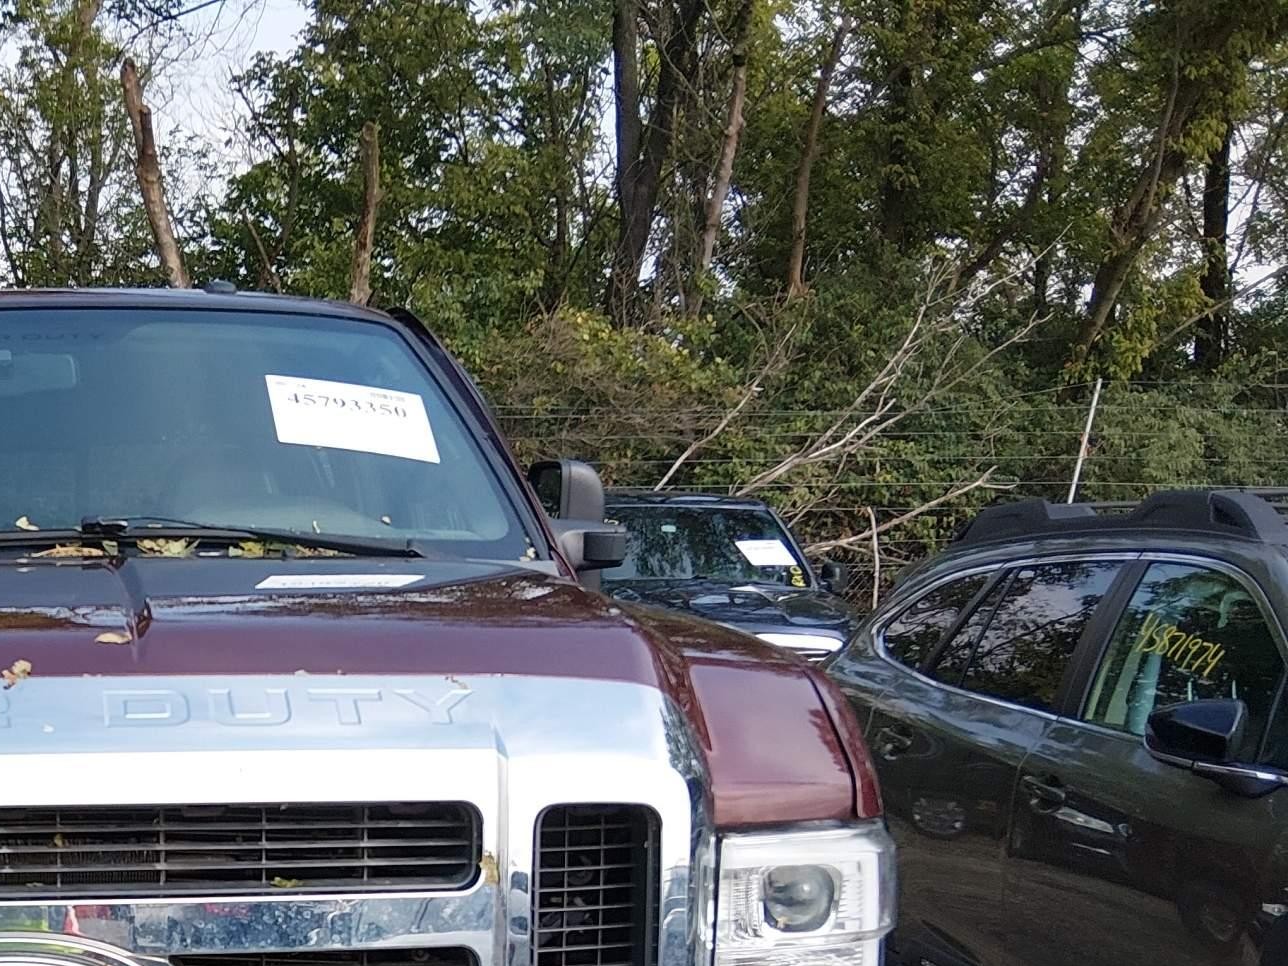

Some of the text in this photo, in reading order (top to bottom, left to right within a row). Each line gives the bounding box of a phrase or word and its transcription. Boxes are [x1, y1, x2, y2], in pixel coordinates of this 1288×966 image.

[287, 392, 408, 419] 45793350
[1136, 612, 1226, 678] 45871974
[103, 688, 474, 728] DUTY
